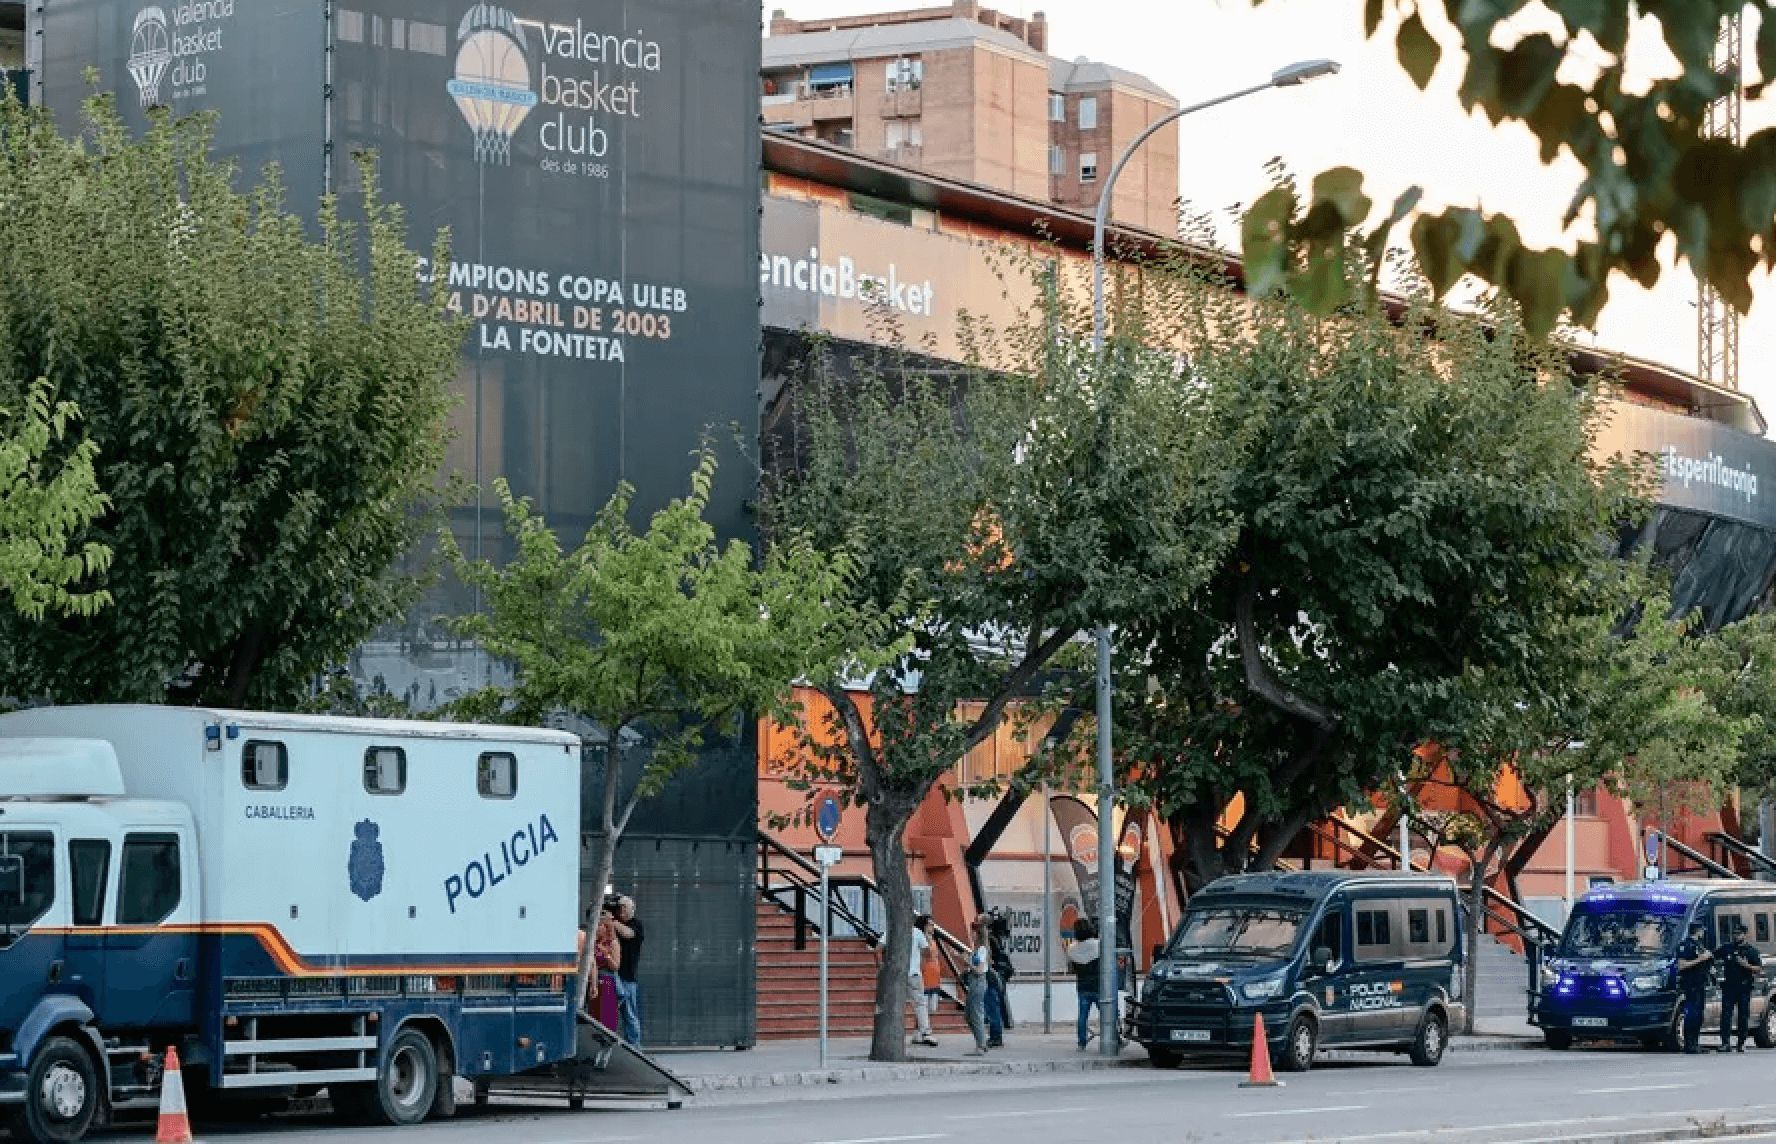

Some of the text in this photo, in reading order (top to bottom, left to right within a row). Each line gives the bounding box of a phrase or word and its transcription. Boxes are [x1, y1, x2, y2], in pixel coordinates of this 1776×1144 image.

[172, 26, 223, 56] basket
[540, 17, 661, 71] valencia
[172, 56, 207, 86] club
[541, 62, 640, 117] basket
[540, 112, 608, 157] club
[540, 157, 561, 172] des
[562, 160, 577, 174] de
[415, 257, 687, 312] CMPIONS COPA ULEB
[472, 293, 564, 327] D'ABRIL
[573, 305, 601, 331] DE
[611, 308, 671, 340] 2003
[481, 324, 625, 362] LA FONTETA
[245, 805, 316, 821] CABALLERIA
[444, 813, 558, 914] POLICIA
